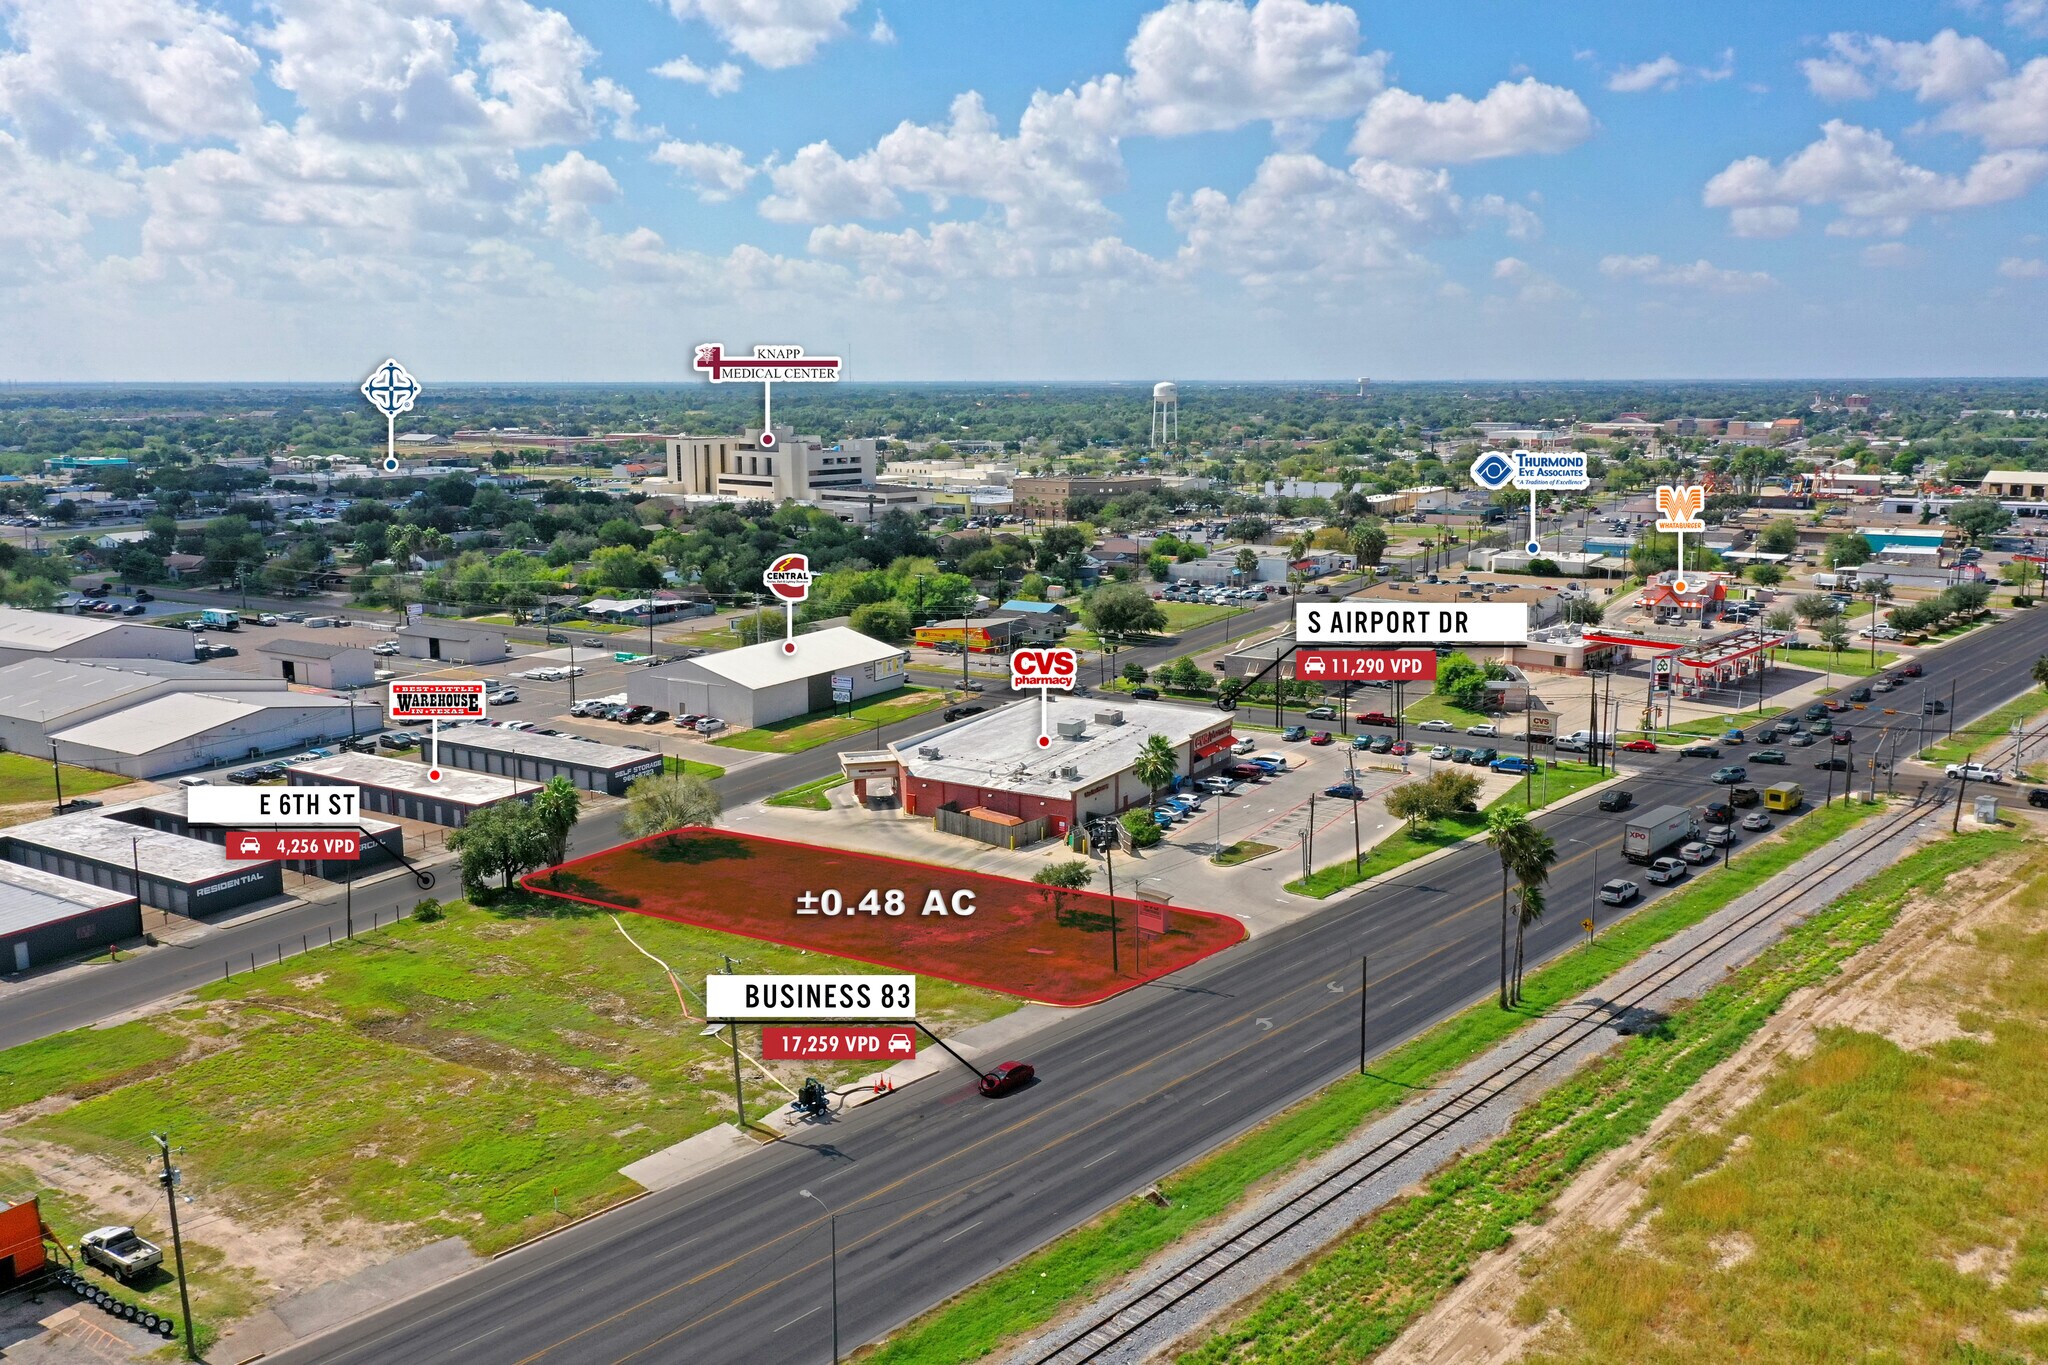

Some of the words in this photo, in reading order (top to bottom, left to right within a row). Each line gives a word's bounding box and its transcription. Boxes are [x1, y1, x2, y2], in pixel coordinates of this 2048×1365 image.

[1533, 717, 1550, 726] CVS
[614, 768, 632, 779] SELF
[633, 759, 662, 773] STORAGE
[1629, 831, 1646, 840] XPO
[196, 872, 264, 897] RESIDENTIAL
